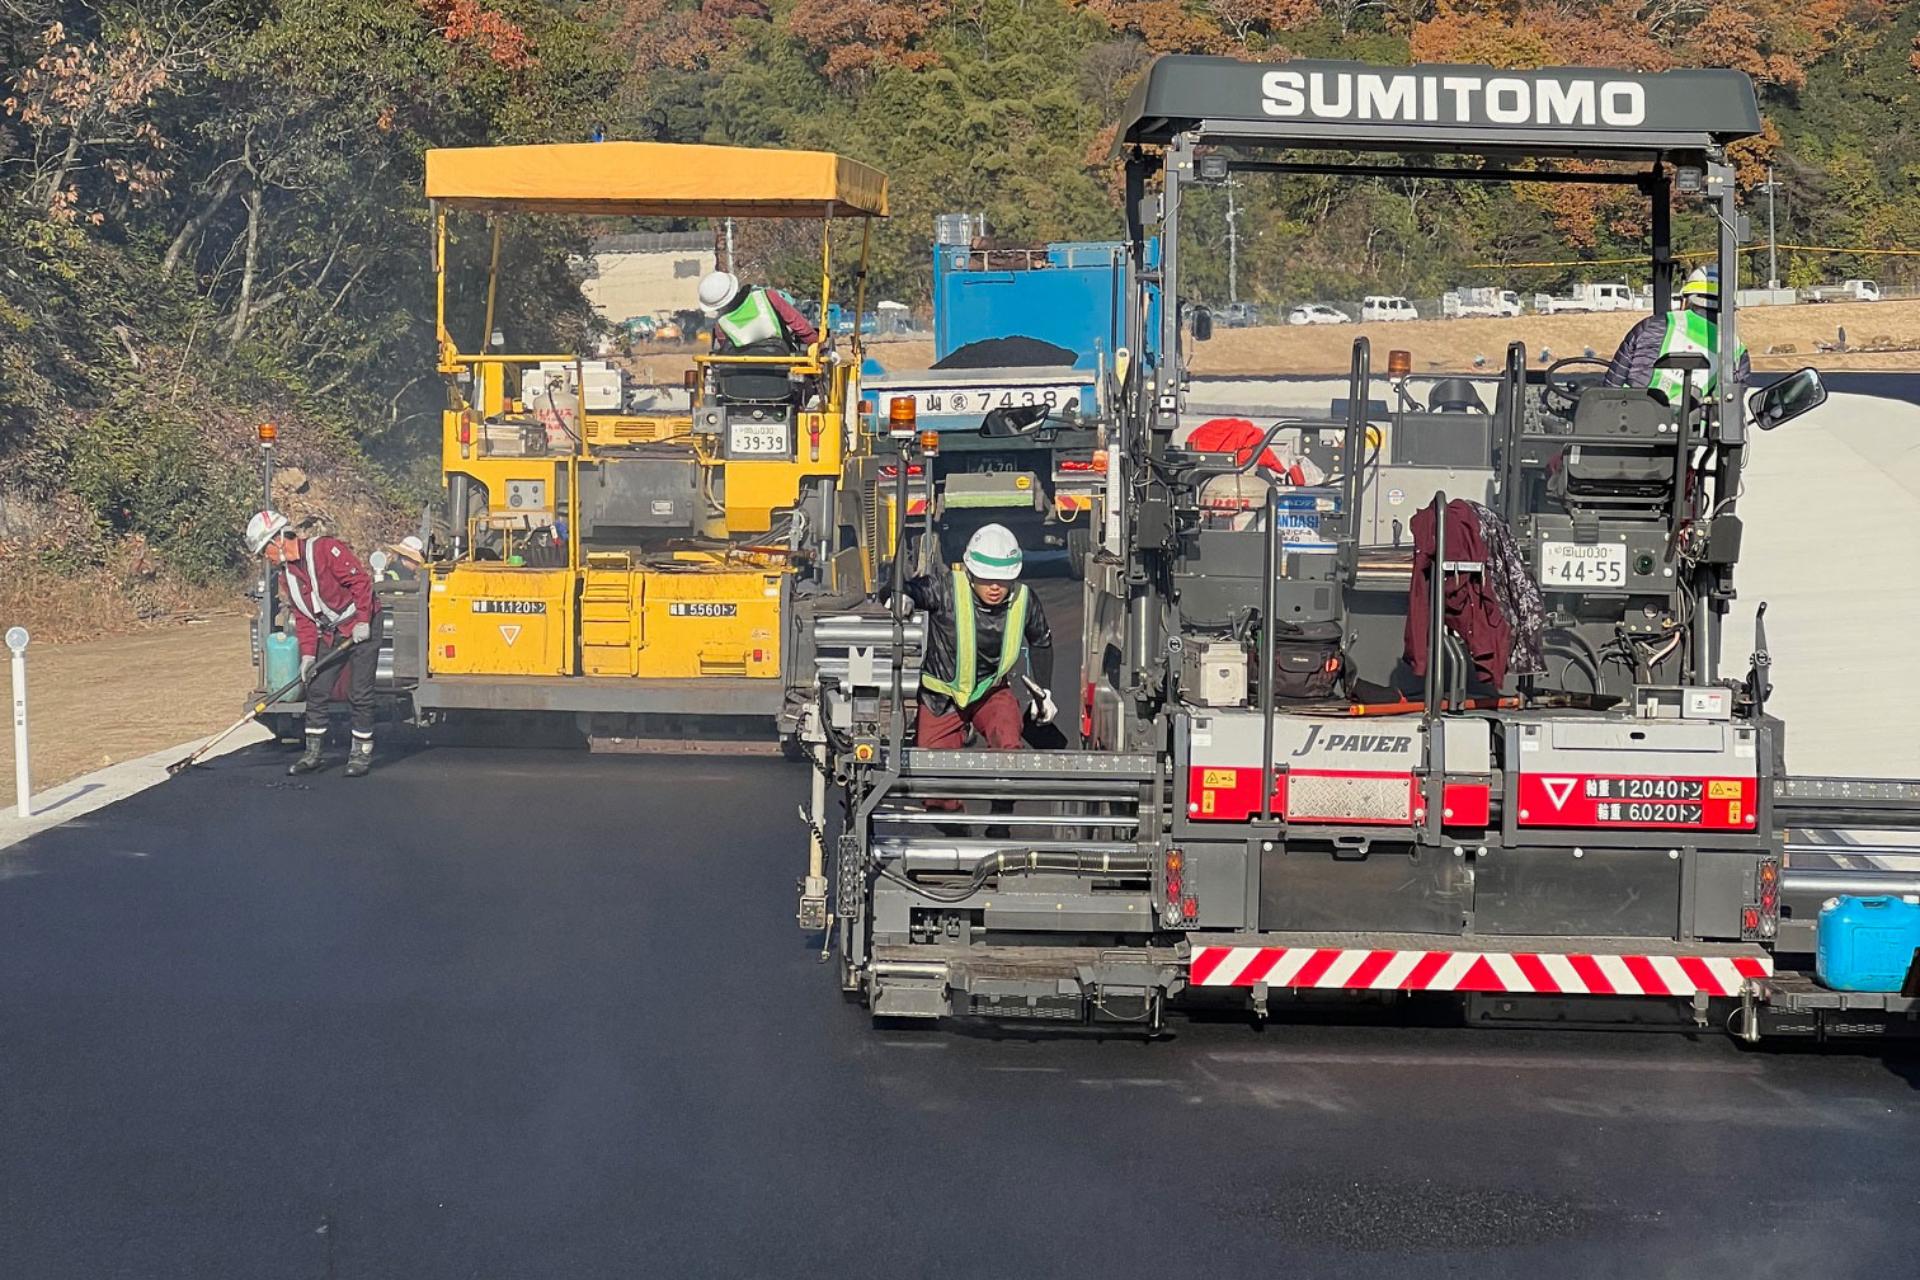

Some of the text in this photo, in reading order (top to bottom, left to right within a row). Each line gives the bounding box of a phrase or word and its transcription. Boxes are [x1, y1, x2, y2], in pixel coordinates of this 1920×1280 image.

[1261, 71, 1646, 127] SUMITOMO
[977, 390, 1058, 411] 7438
[743, 436, 783, 450] 39-39
[1561, 560, 1622, 583] 44-55
[1629, 803, 1702, 822] 6.020トン
